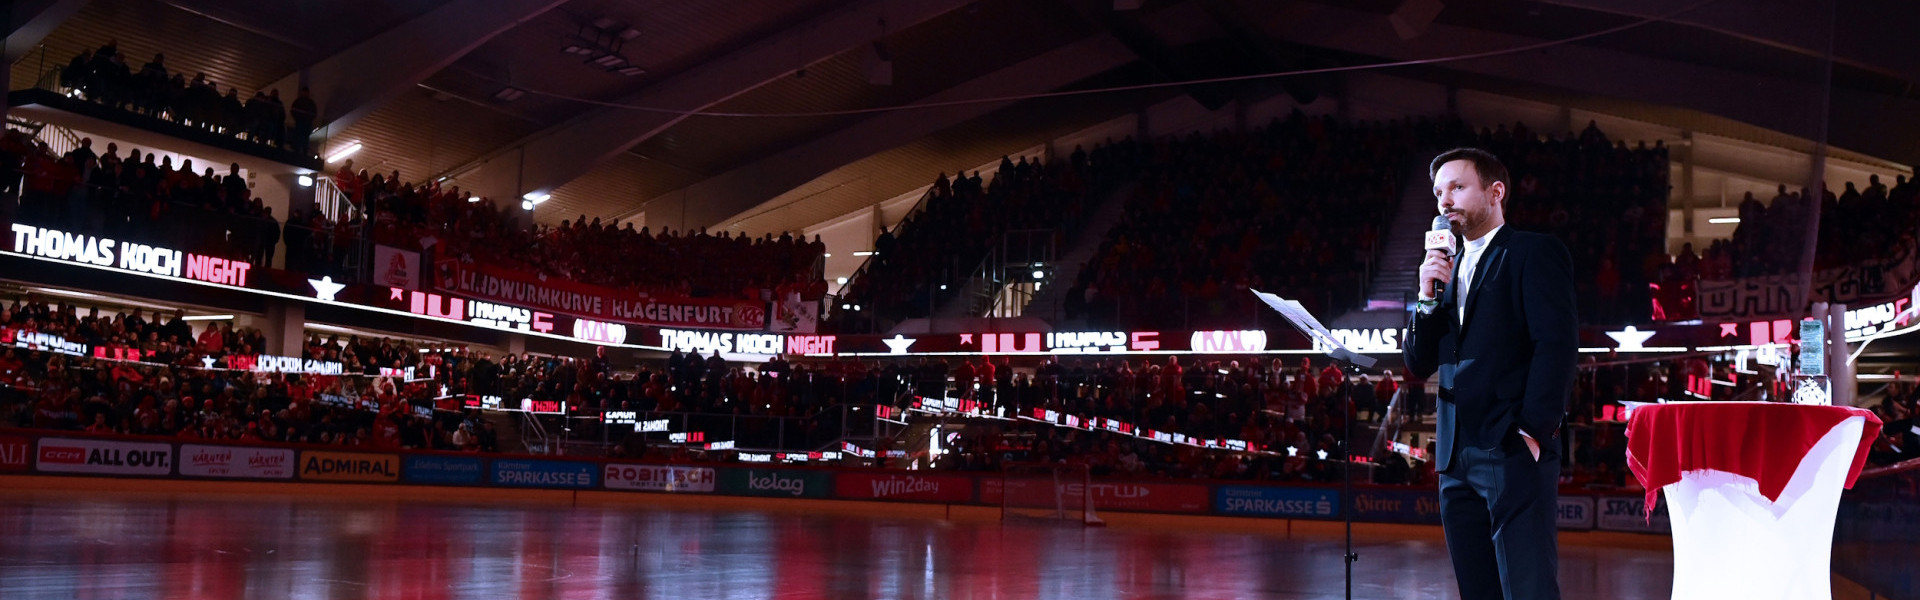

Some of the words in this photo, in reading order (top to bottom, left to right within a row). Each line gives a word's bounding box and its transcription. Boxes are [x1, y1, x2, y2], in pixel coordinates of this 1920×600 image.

[11, 222, 116, 267] THOMAS
[119, 241, 182, 278] KOCH
[186, 252, 251, 287] NIGHT
[659, 328, 733, 353] THOMAS
[736, 333, 784, 354] KOCH
[787, 335, 836, 355] NIGHT
[87, 448, 124, 466] ALL
[126, 450, 169, 468] OUT.
[304, 457, 395, 477] ADMIRAL
[498, 470, 575, 484] SPARKASSE
[607, 467, 713, 484] ROBITSCH
[749, 470, 804, 496] kelag
[871, 475, 940, 498] win2day
[1225, 498, 1314, 514] SPARKASSE
